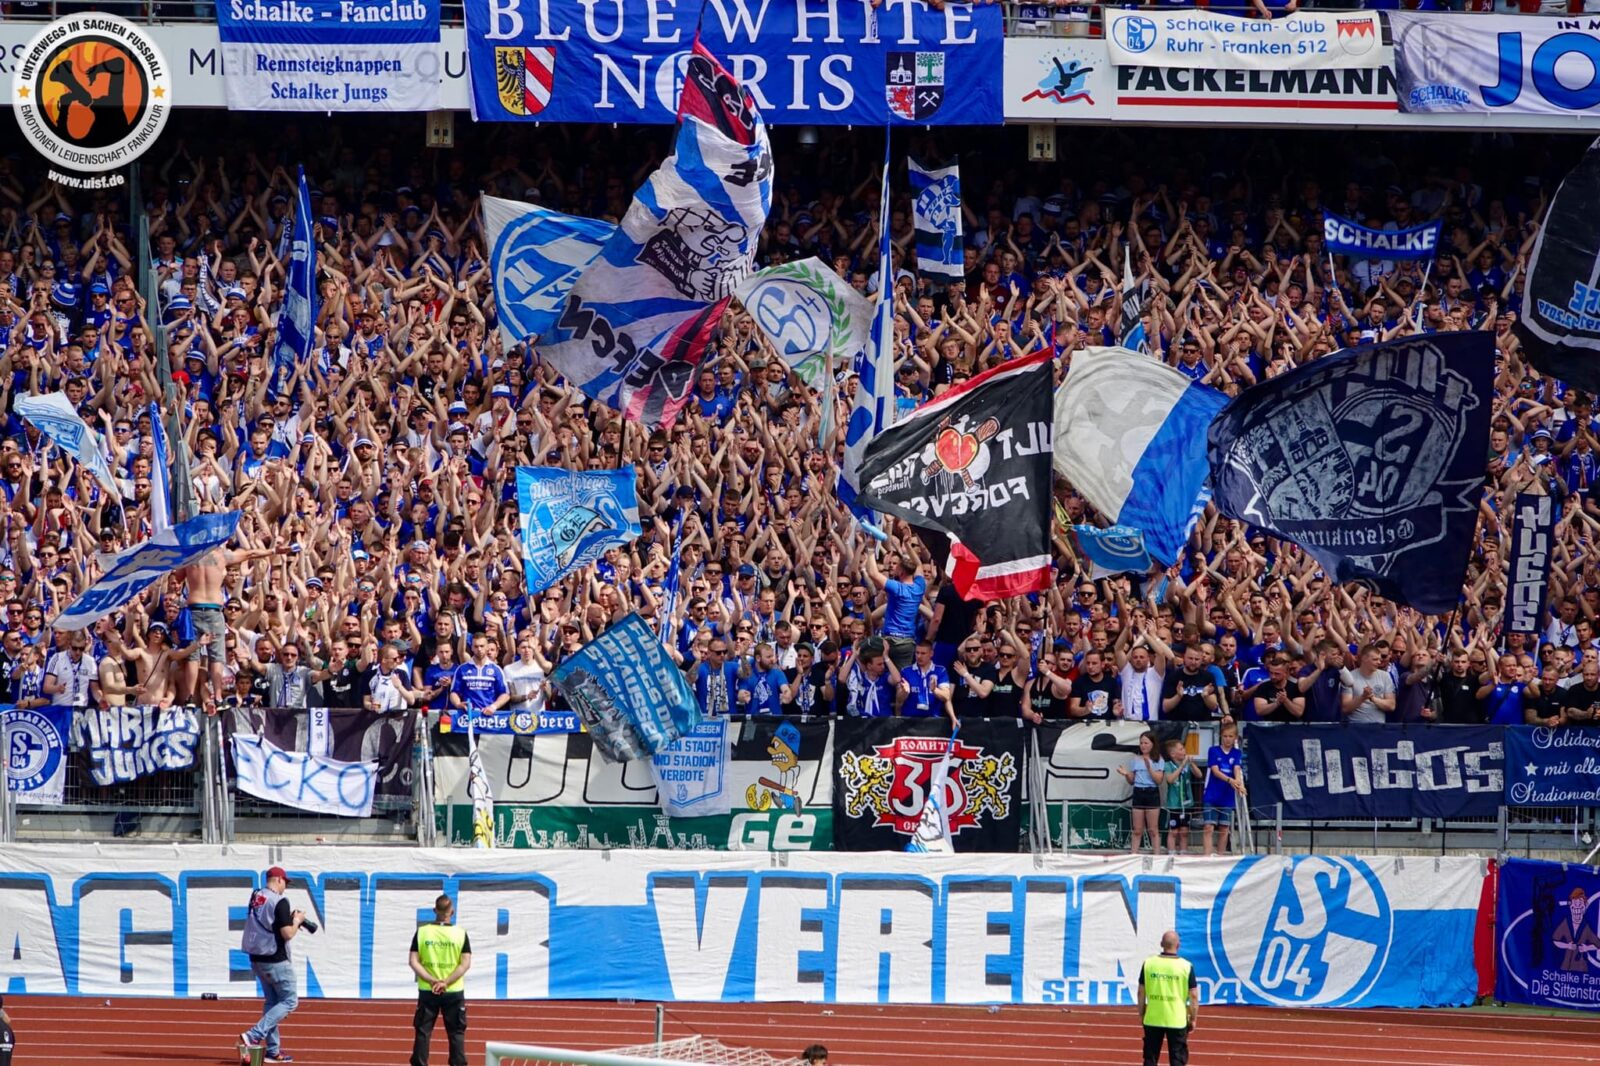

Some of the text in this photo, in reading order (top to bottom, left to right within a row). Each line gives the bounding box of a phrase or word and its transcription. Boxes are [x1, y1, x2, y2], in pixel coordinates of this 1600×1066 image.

[230, 0, 314, 22] Schalke
[340, 0, 427, 22] Fanclub
[484, 0, 977, 45] BLUE WHITE
[1166, 18, 1235, 33] Schalke
[1286, 19, 1325, 33] Club
[1557, 21, 1580, 29] IN
[1166, 38, 1204, 53] Ruhr
[1222, 40, 1292, 54] Franken
[1297, 40, 1327, 54] 512
[256, 55, 402, 75] Rennsteigknappen
[1117, 67, 1398, 95] FACKELMANN
[271, 82, 388, 103] Schalker Jungs
[1410, 85, 1471, 105] SCHALKE
[1324, 218, 1437, 250] SCHALKE
[1512, 496, 1551, 631] HUGOS
[696, 725, 721, 734] SIEGEN
[685, 741, 721, 752] STADT-
[90, 730, 195, 786] JUNGS
[673, 755, 720, 767] STADION-
[660, 770, 705, 781] VERBOTE
[1269, 738, 1504, 801] HUGOS
[1543, 761, 1571, 776] mit
[727, 813, 817, 850] Ge
[0, 872, 556, 1000] AGENER
[648, 872, 1180, 1003] VEREIN
[1542, 969, 1580, 983] Schalke
[1042, 980, 1134, 1004] SEIT
[1531, 980, 1550, 995] Die
